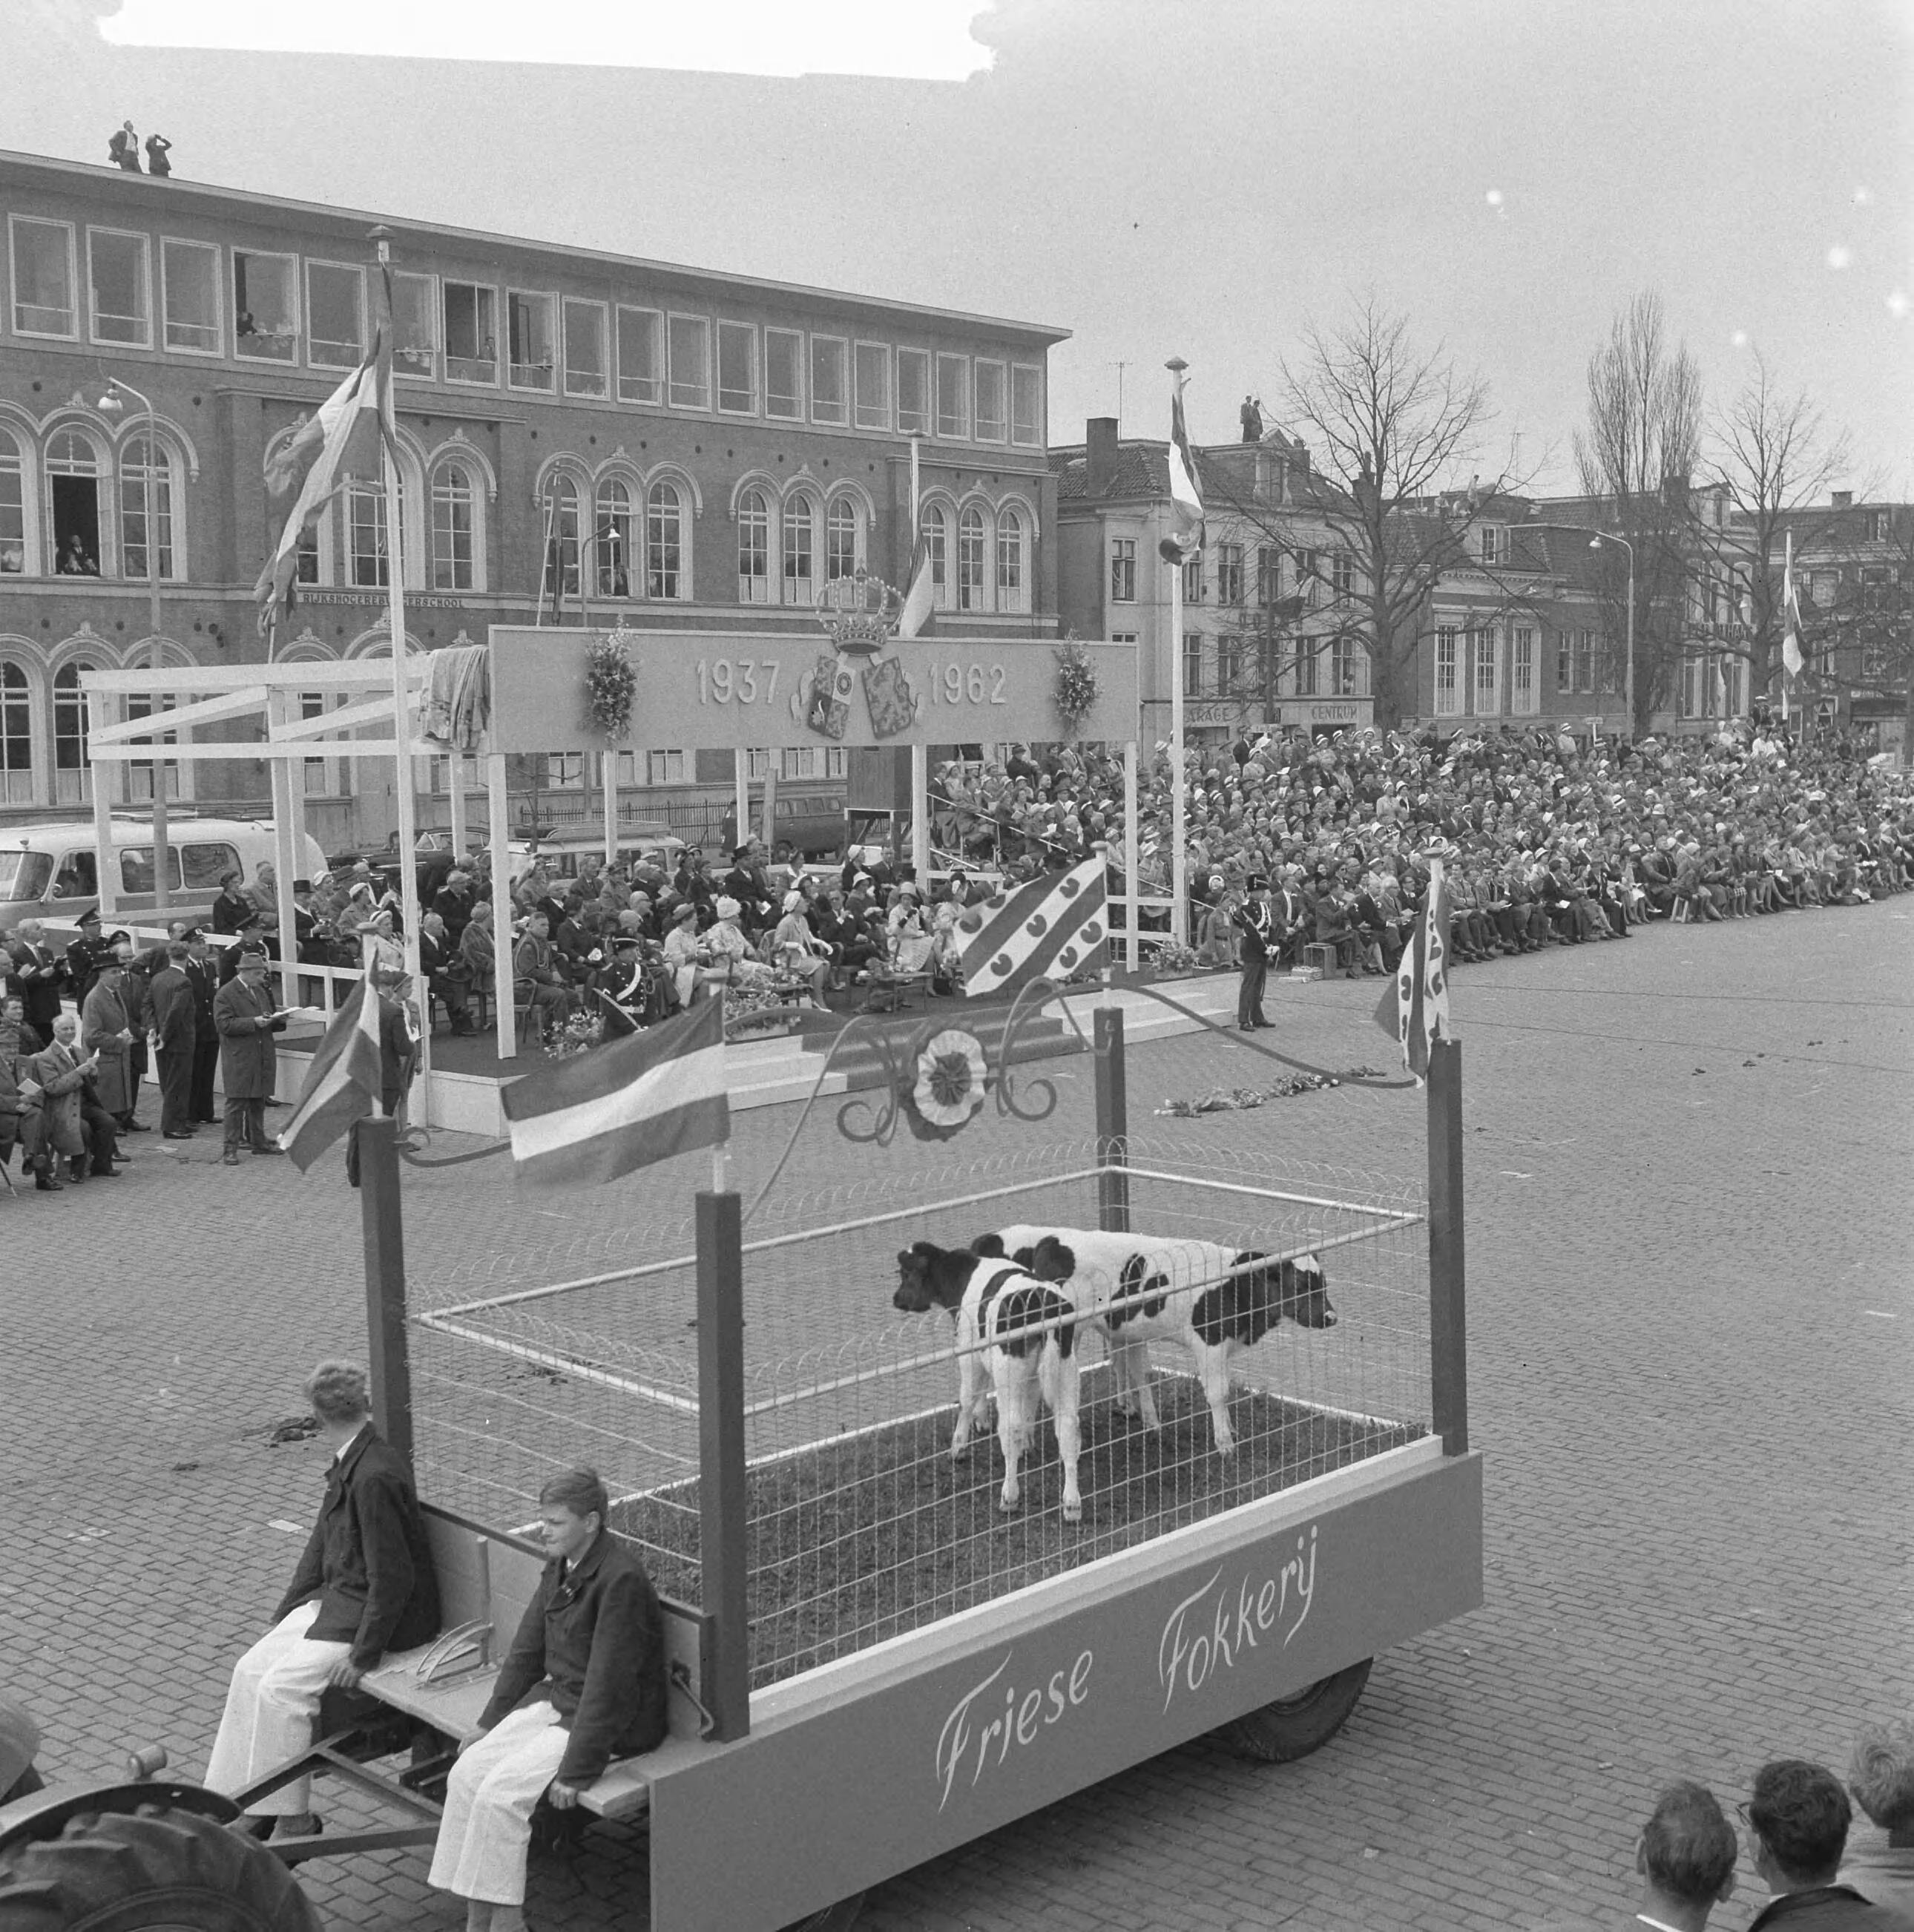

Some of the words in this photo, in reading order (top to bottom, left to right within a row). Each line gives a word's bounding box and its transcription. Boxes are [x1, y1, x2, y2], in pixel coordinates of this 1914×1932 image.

[696, 659, 781, 705] 1937
[930, 663, 1007, 704] 1962
[1184, 706, 1229, 722] ARAGE
[1312, 706, 1357, 719] CENTRUM
[936, 1650, 1093, 1814] Friese
[1159, 1525, 1318, 1715] Fokkerij
